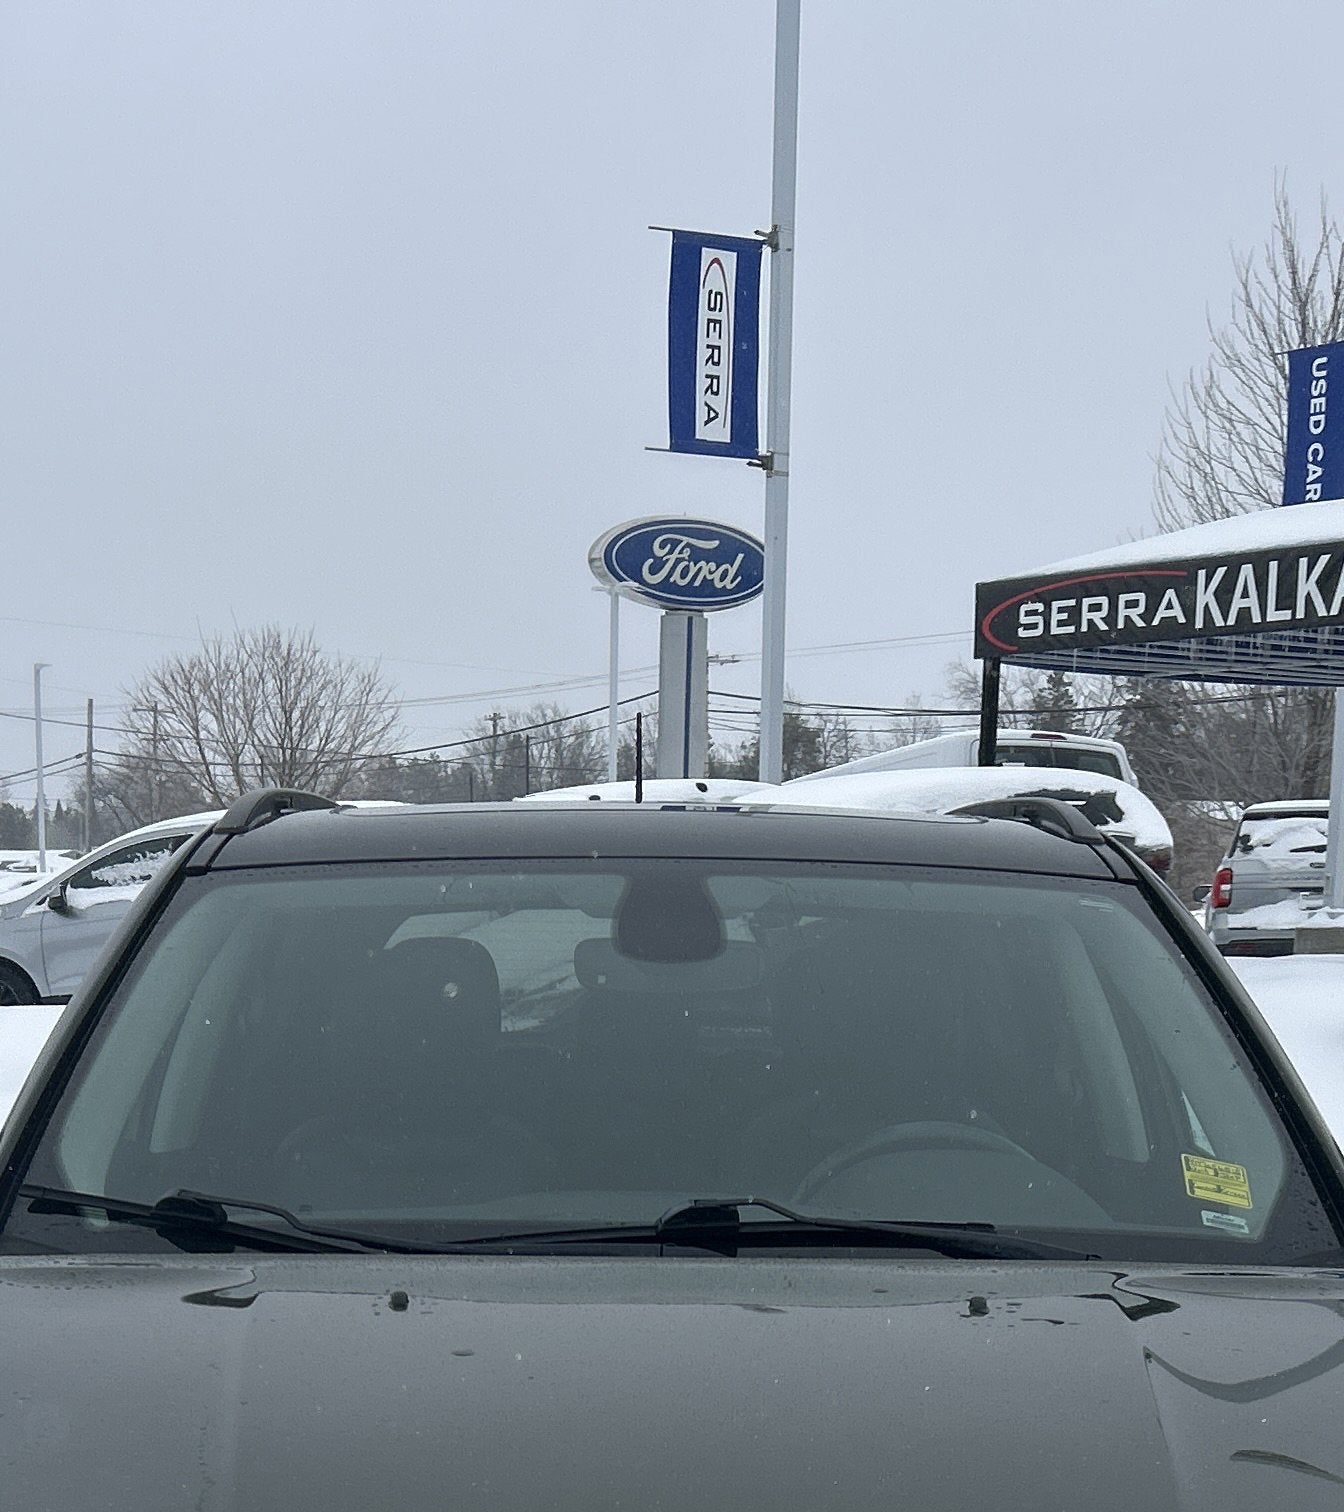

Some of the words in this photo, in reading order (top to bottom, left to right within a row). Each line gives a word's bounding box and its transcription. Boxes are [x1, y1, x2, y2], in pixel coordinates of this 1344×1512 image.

[703, 288, 724, 427] SERRA
[1308, 356, 1329, 435] USED
[641, 533, 745, 590] Ford
[1016, 588, 1187, 639] SERRA
